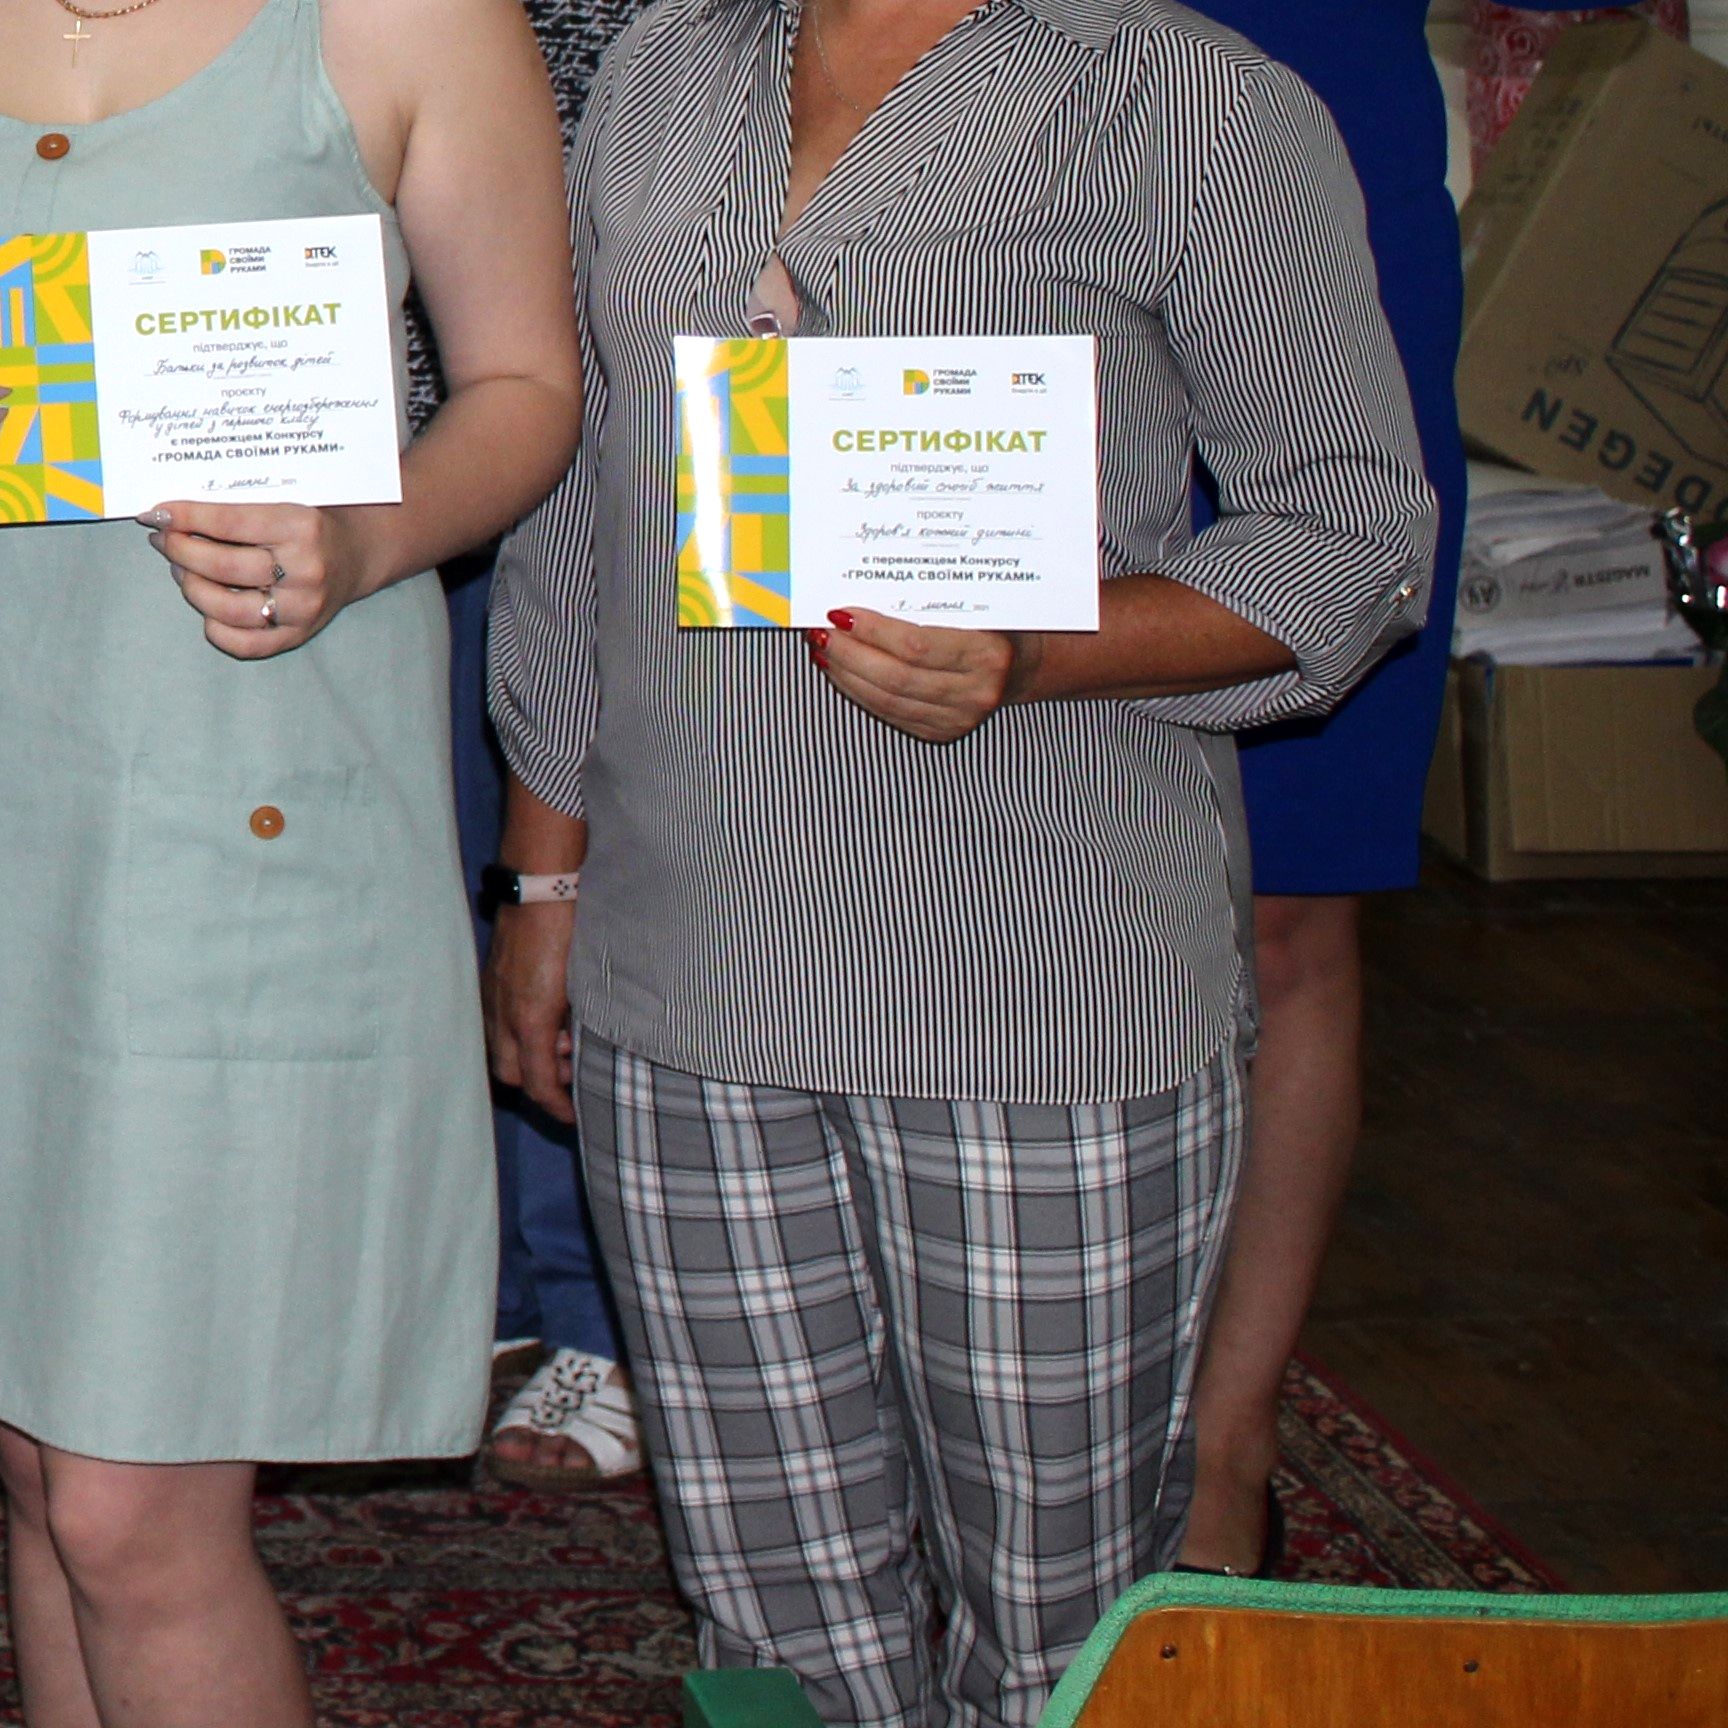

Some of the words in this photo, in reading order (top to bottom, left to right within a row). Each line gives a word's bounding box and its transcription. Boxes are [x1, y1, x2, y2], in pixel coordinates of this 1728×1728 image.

[229, 246, 271, 255] ГРОМАДА
[230, 265, 266, 273] РУКАМИ
[135, 303, 341, 336] СЕРТИФІКАТ
[193, 341, 268, 354] підтверджує,
[271, 339, 288, 349] що
[228, 356, 287, 375] розвиток
[291, 352, 333, 371] дітей
[934, 369, 977, 377] ГРОМАДА
[221, 387, 267, 398] проєкту
[934, 387, 971, 395] РУКАМИ
[181, 433, 262, 447] переможцем
[266, 429, 324, 443] Конкурсу
[832, 430, 1046, 452] СЕРТИФІКАТ
[152, 451, 222, 463] «ГРОМАДА
[226, 445, 280, 459] СВОЇМИ
[284, 443, 344, 455] РУКАМИ»
[891, 463, 968, 475] підтверджує,
[971, 464, 989, 474] що
[917, 510, 963, 521] проєкту
[872, 556, 956, 567] переможцем
[960, 556, 1020, 568] Конкурсу
[843, 570, 913, 582] «ГРОМАДА
[918, 568, 974, 581] СВОЇМИ
[978, 571, 1041, 581] РУКАМИ»
